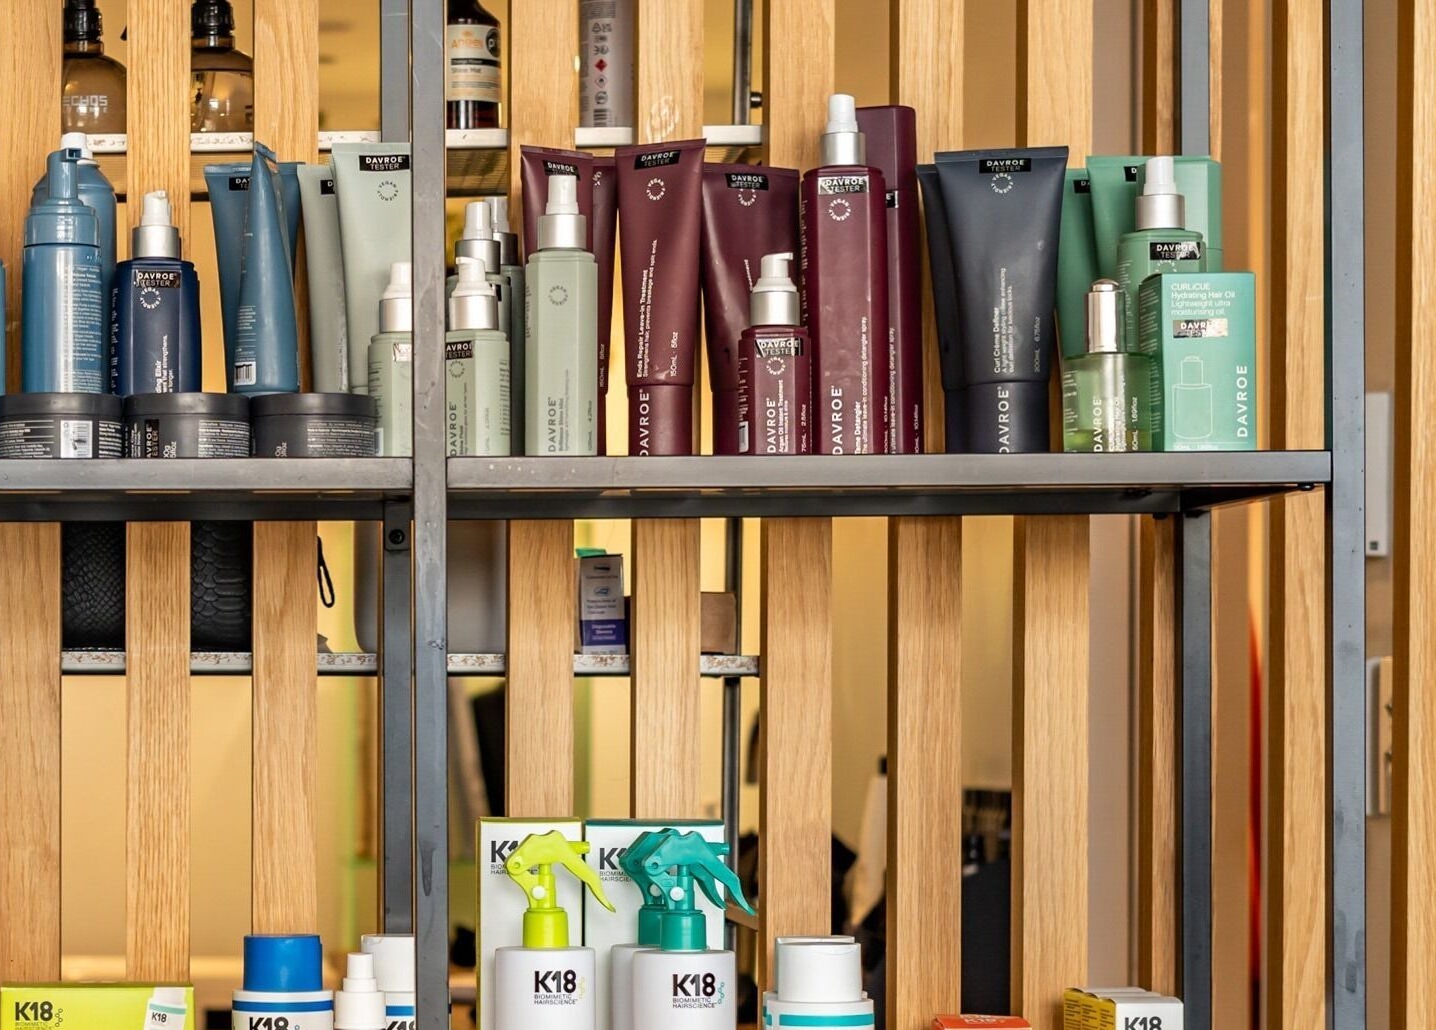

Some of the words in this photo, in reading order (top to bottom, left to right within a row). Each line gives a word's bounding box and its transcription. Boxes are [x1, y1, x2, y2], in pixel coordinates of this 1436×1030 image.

[365, 156, 404, 164] DAVROE
[370, 163, 400, 171] TESTER
[547, 161, 575, 173] DAVROE
[640, 151, 675, 162] DAVROE
[643, 158, 670, 167] TESTER
[731, 174, 764, 183] DAVROE
[826, 178, 864, 186] DAVROE
[832, 185, 861, 193] TESTER
[137, 272, 175, 280] DAVROE
[639, 269, 648, 304] Treatment
[1171, 290, 1207, 300] Hydrating
[1208, 290, 1224, 299] Hair
[1225, 290, 1236, 299] Oil
[1171, 299, 1214, 309] Lightweight
[1214, 299, 1231, 308] ultra
[638, 305, 646, 336] Leave-in
[992, 307, 1001, 332] Definer
[1171, 308, 1214, 317] moisturising
[992, 333, 1001, 357] Crème
[154, 360, 162, 377] Elixir
[670, 355, 678, 377] 150mL
[861, 360, 869, 396] conditioning
[1236, 365, 1248, 438] DAVROE
[547, 398, 557, 452] DAVROE
[767, 400, 776, 454] DAVROE
[831, 387, 843, 455] DAVROE
[854, 400, 863, 436] Detangler
[1093, 399, 1103, 452] DAVROE
[449, 404, 457, 456] DAVROE
[534, 969, 577, 994] K18
[672, 972, 716, 997] K18
[14, 1001, 54, 1022] K18
[151, 1012, 168, 1023] K18
